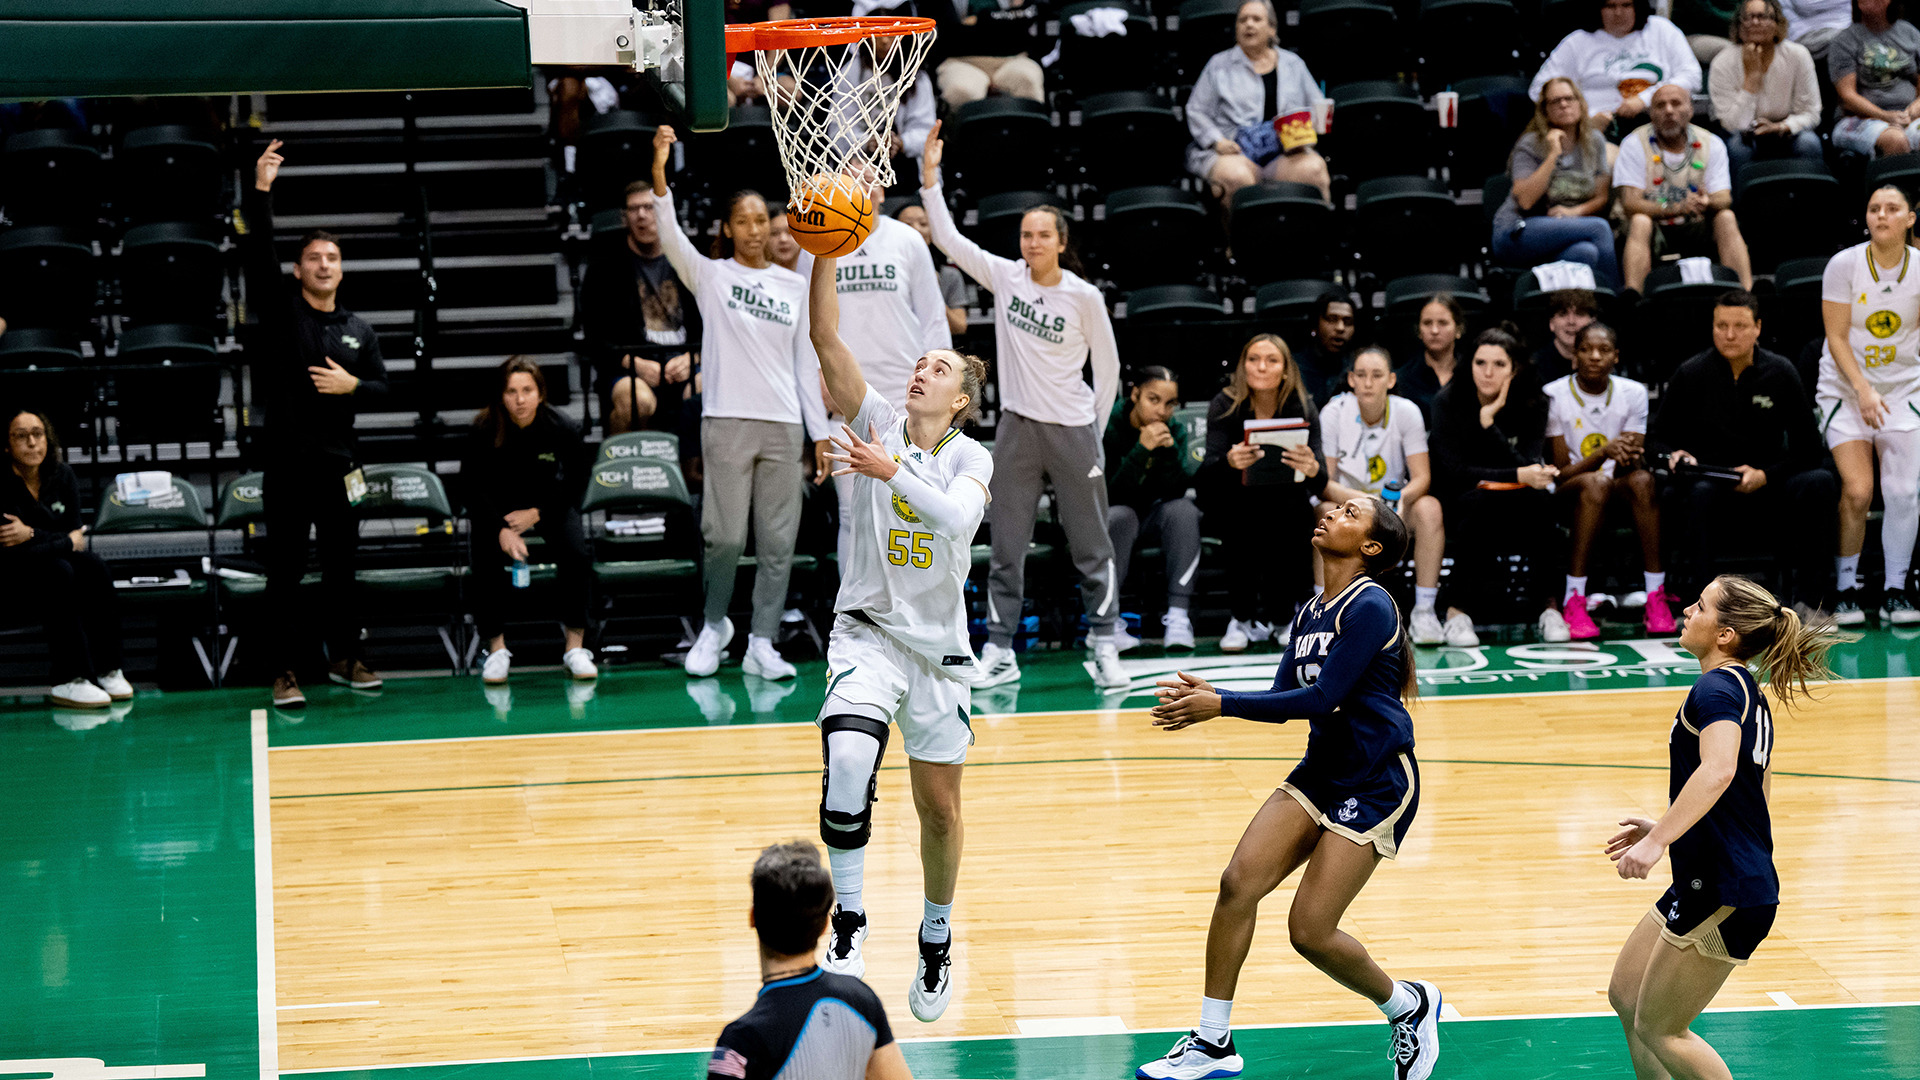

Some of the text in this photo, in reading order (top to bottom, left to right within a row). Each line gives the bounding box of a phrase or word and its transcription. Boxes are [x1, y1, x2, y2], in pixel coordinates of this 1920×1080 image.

[786, 205, 826, 228] Wilso
[836, 264, 896, 282] BULLS
[836, 282, 898, 294] ASKETBALL
[1008, 295, 1066, 333] BULLS
[366, 481, 388, 494] GH
[888, 528, 934, 570] 55
[1416, 671, 1547, 685] EDIT
[1574, 664, 1703, 679] UNIO
